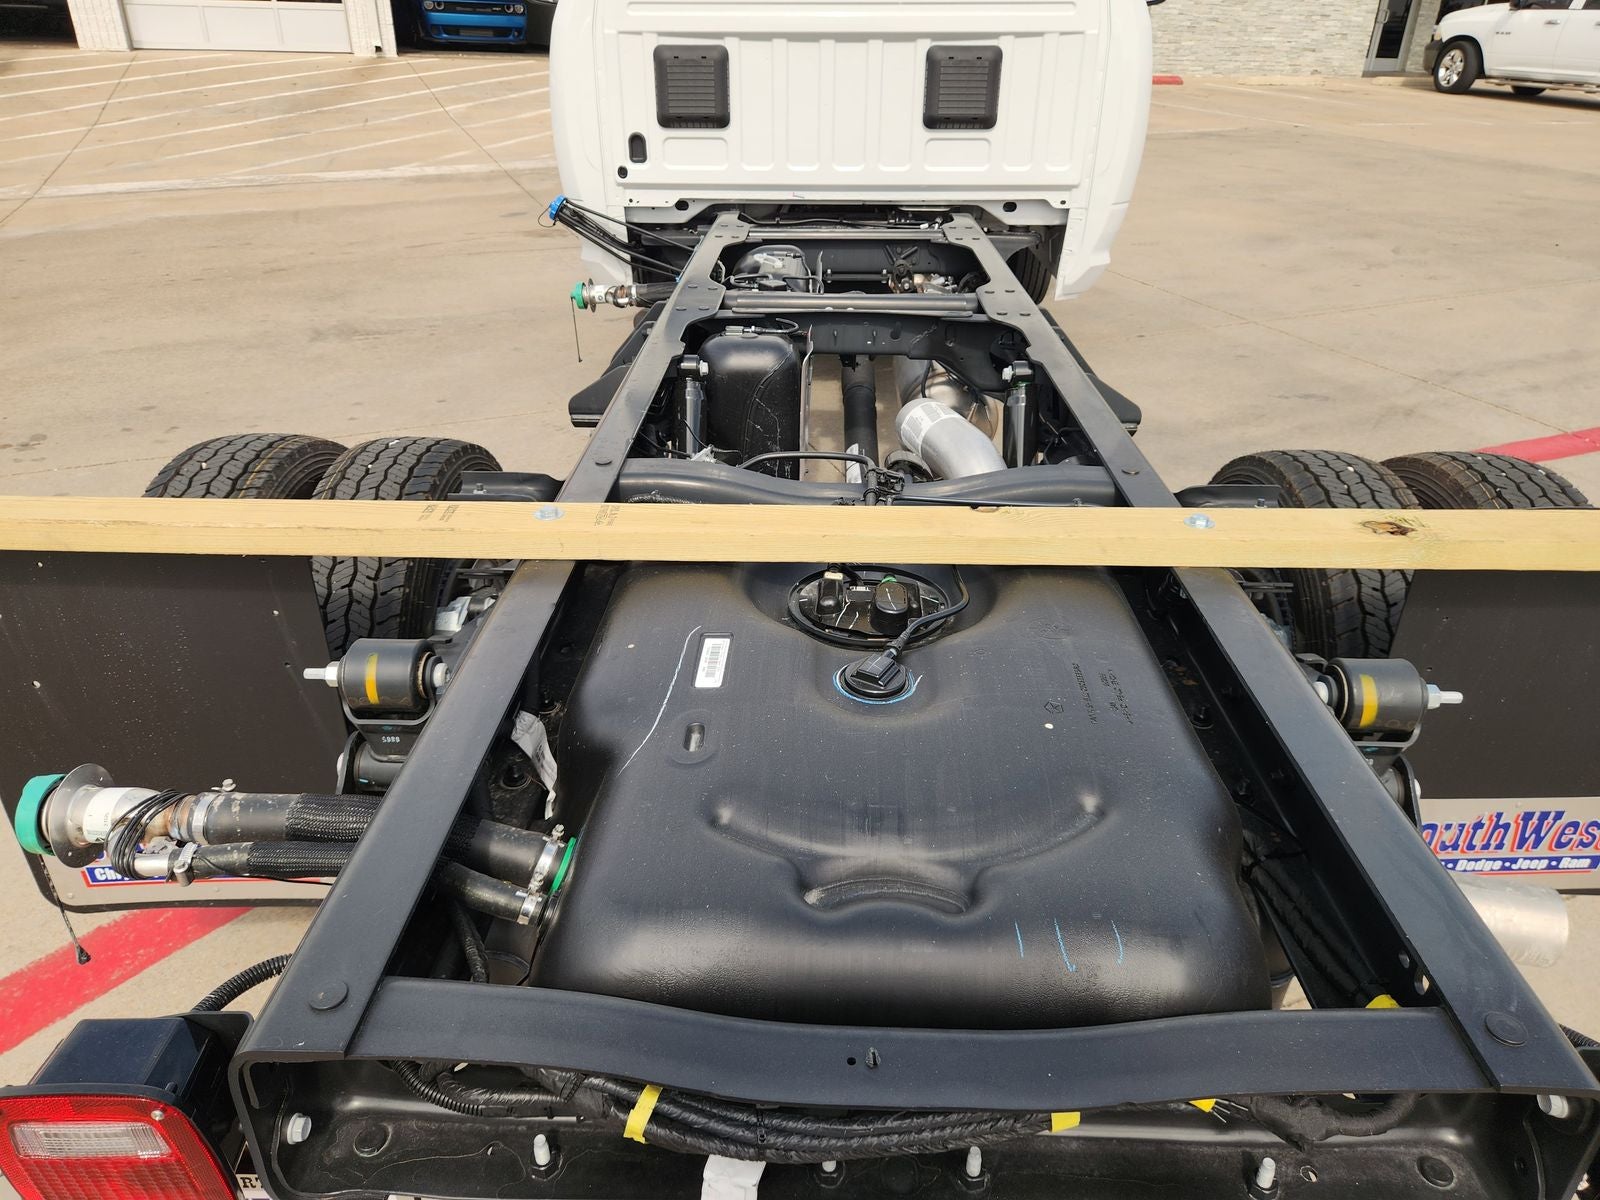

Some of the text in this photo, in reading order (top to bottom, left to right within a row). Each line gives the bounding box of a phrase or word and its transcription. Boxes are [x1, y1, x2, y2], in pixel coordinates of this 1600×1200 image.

[1455, 859, 1502, 872] Dodge
[1511, 857, 1549, 871] Jeep
[1558, 856, 1592, 869] Ram
